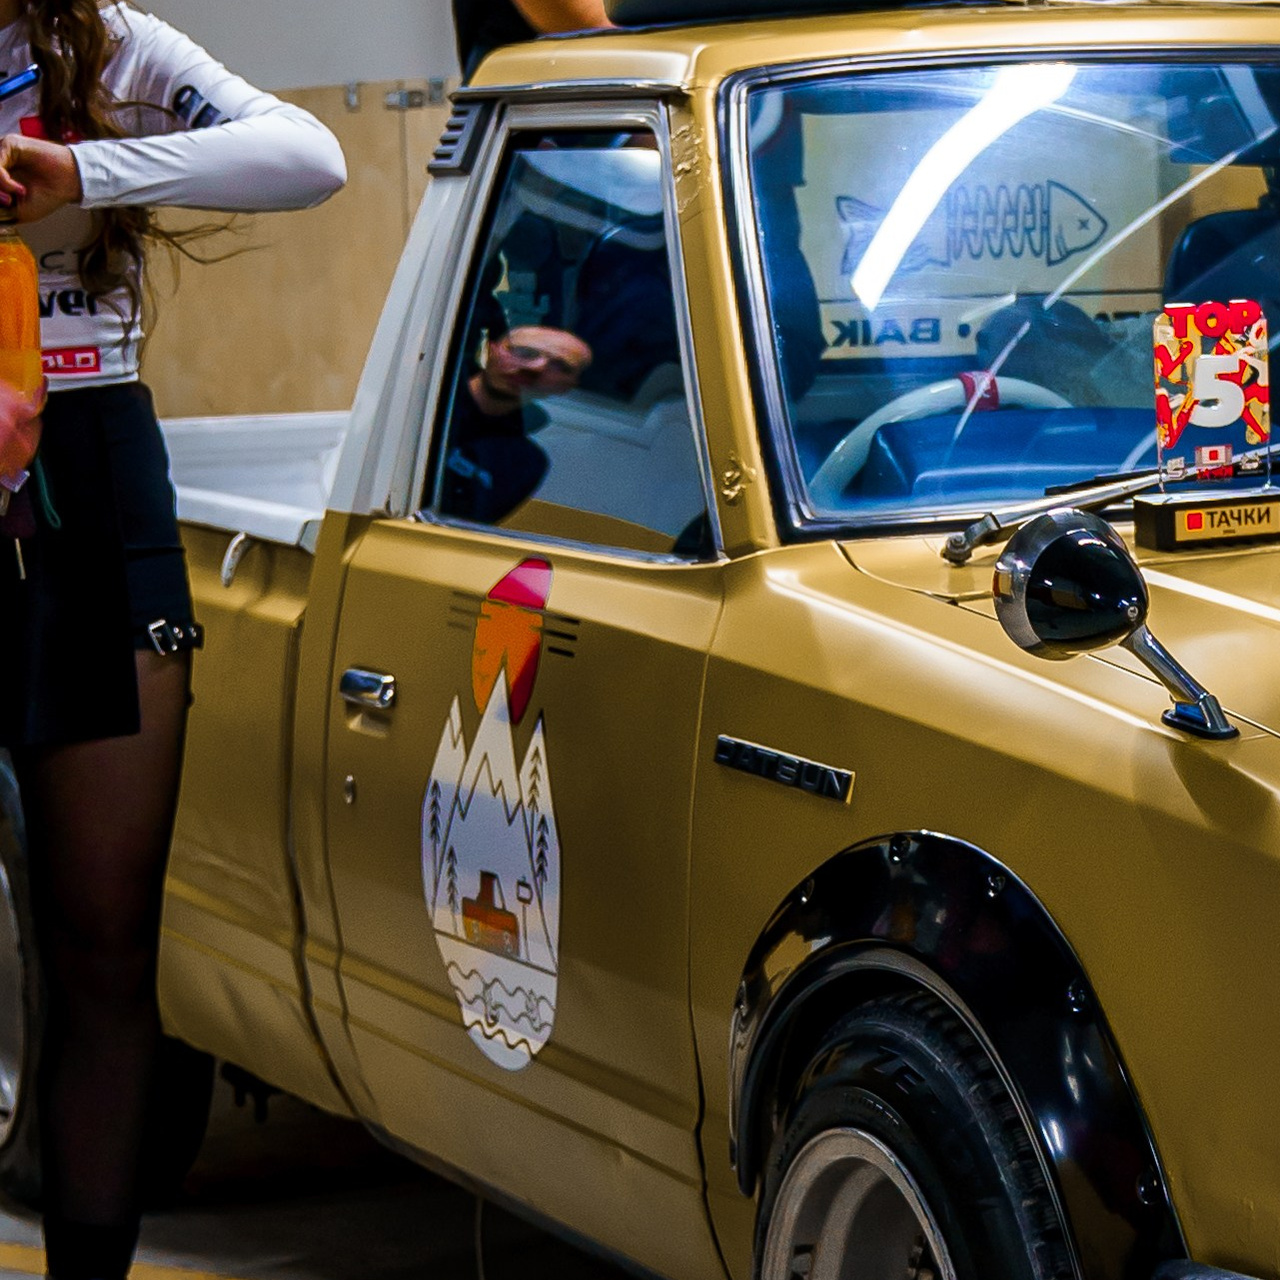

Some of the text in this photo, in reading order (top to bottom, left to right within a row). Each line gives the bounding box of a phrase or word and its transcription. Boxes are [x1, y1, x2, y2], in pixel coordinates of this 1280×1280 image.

[1163, 299, 1263, 339] TOP
[1188, 354, 1246, 428] 5
[1206, 507, 1271, 529] ТАЧКИ
[714, 735, 850, 801] DATSUN
